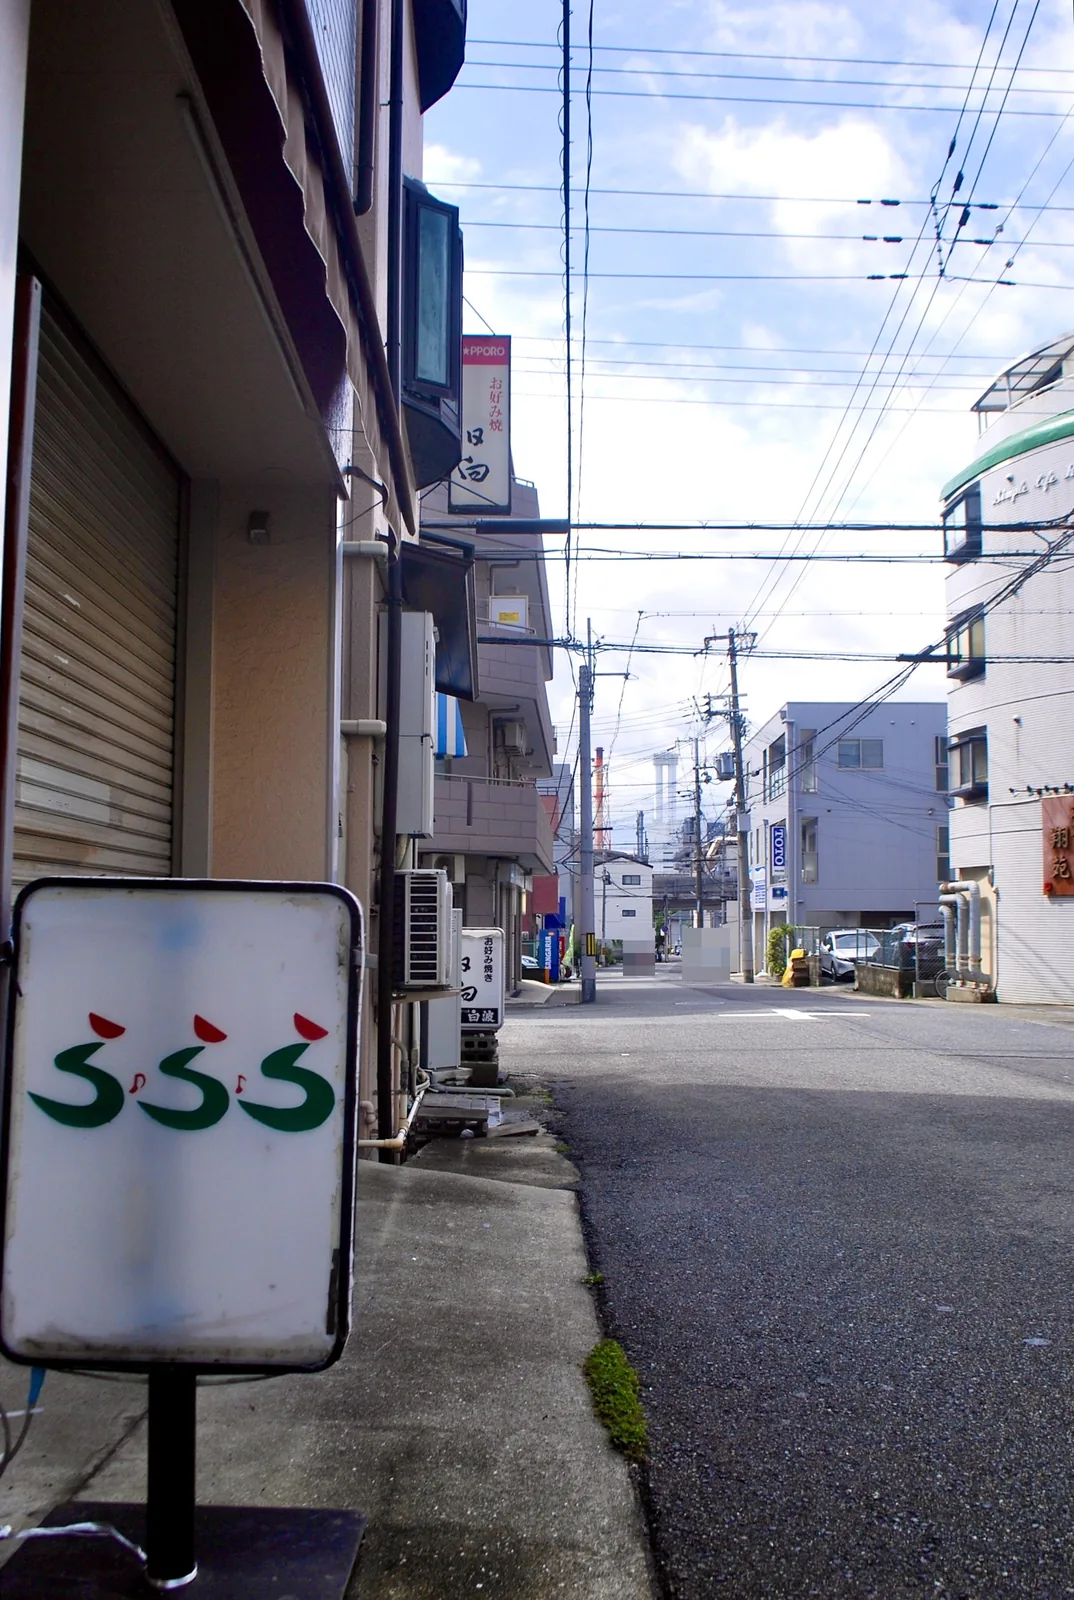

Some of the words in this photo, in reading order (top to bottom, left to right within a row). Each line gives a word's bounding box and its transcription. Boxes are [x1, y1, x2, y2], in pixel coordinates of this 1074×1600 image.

[463, 346, 505, 356] PPORO
[489, 377, 503, 432] お好み焼
[774, 828, 784, 865] TOTO
[483, 937, 494, 983] お好み焼き
[544, 936, 552, 969] SANGARIA
[467, 1009, 495, 1023] 白波
